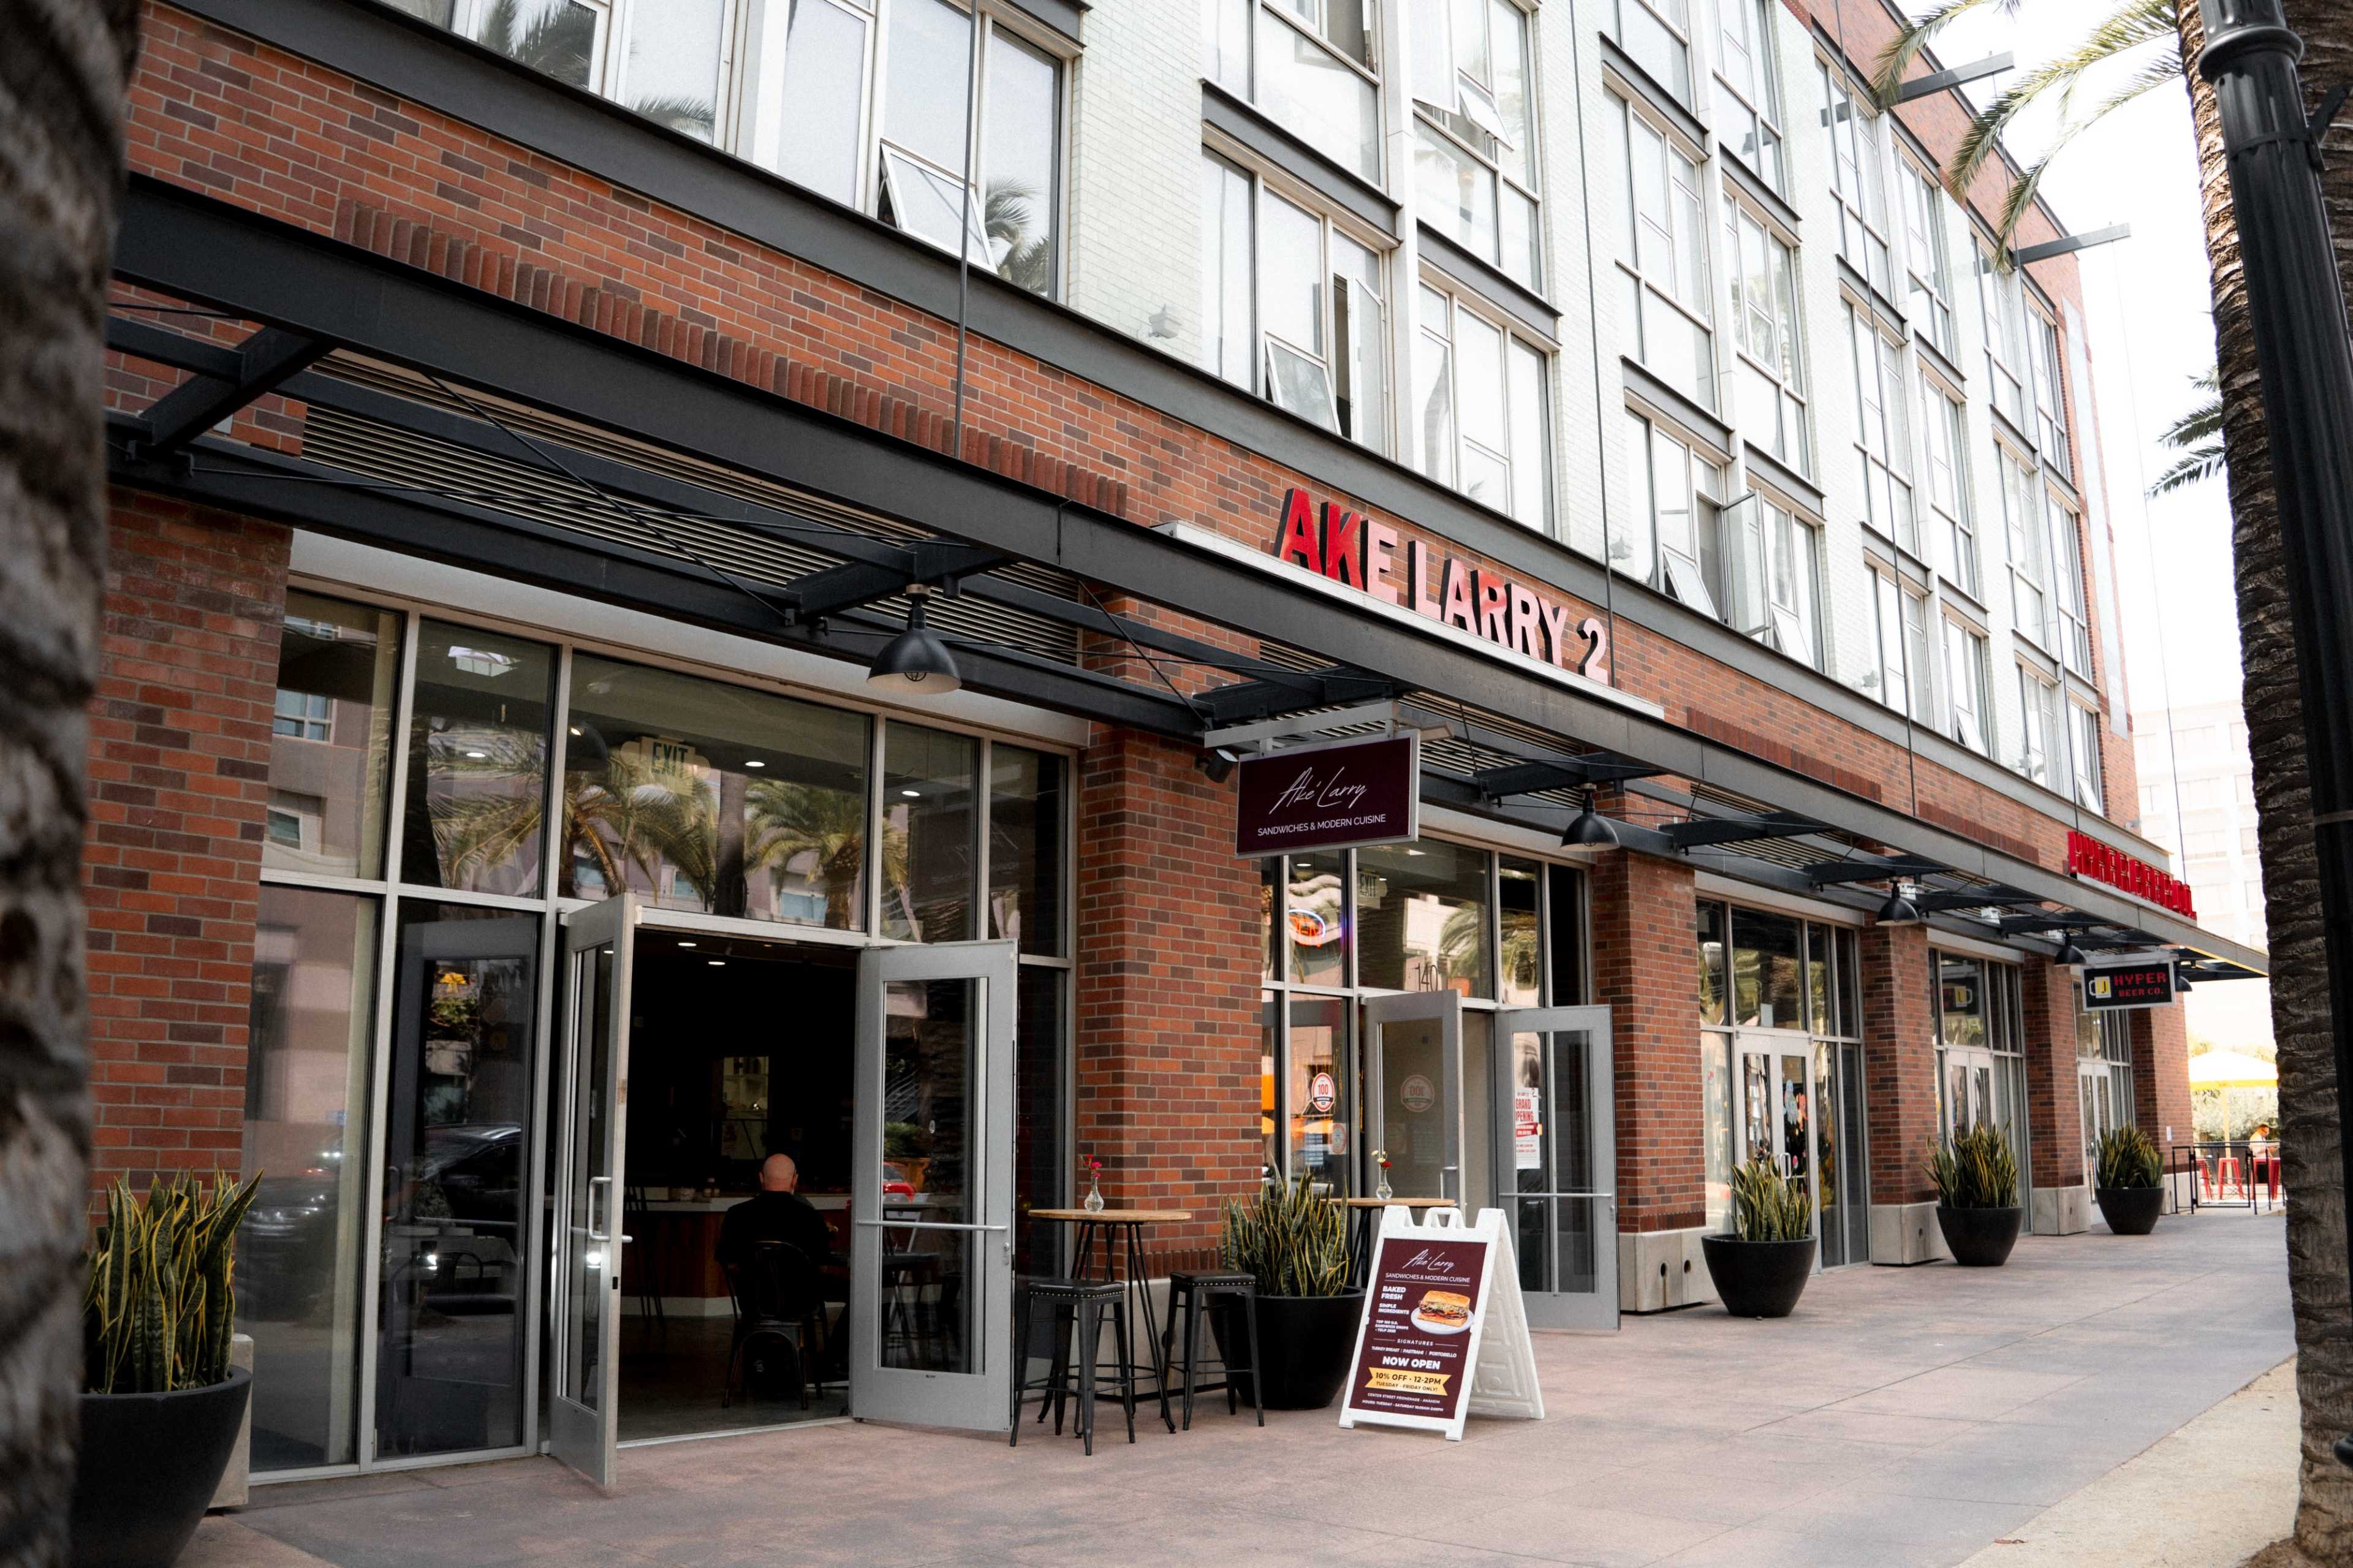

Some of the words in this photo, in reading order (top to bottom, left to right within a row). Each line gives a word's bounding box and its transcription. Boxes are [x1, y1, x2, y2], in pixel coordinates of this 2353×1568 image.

[1275, 488, 1398, 605] AKE
[1409, 540, 1568, 668] LARRY
[1577, 618, 1608, 686] 2
[651, 741, 688, 778] EXIT
[1317, 767, 1368, 809] Larry
[1258, 822, 1308, 836] SANDWICHES
[1317, 818, 1352, 829] MODERN
[1354, 814, 1386, 825] CUISINE
[1360, 874, 1377, 897] EXIT
[1413, 963, 1438, 991] 140
[2115, 972, 2167, 987] HYPER
[2119, 988, 2145, 997] BEER
[1318, 1084, 1328, 1095] 100
[1516, 1099, 1531, 1110] GRAND
[1427, 1252, 1454, 1273] Larry
[1382, 1356, 1409, 1366] NOW
[1411, 1359, 1441, 1369] OPEN
[1414, 1376, 1441, 1385] 12-2PM
